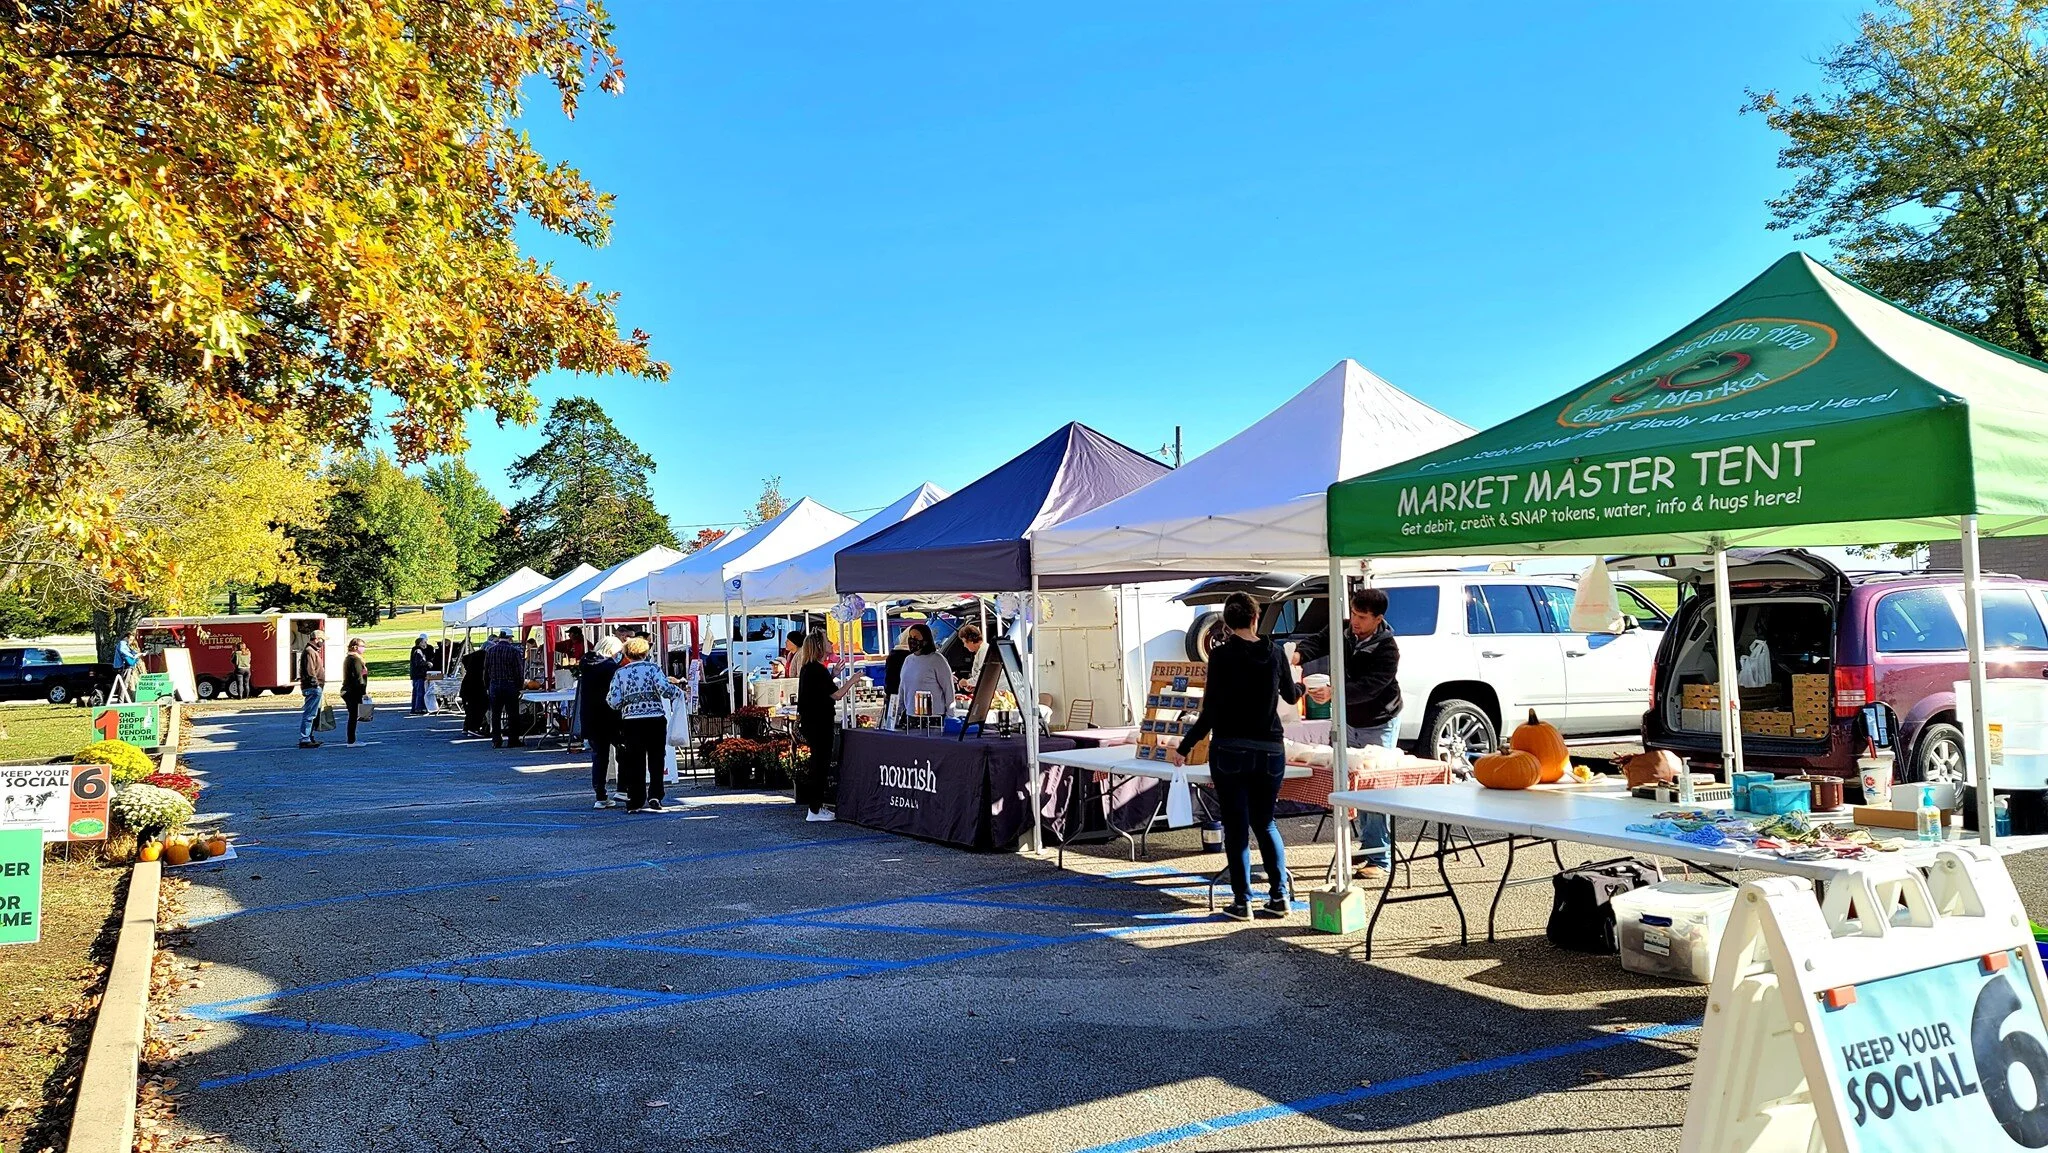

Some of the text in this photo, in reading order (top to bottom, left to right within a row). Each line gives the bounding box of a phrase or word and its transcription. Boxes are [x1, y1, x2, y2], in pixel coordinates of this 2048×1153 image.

[1610, 322, 1816, 385] The Sedalia Area
[1654, 372, 1770, 409] Market
[1628, 415, 1698, 430] Gladly
[1699, 400, 1820, 424] Accepted
[1819, 388, 1899, 411] Here!
[1397, 438, 1817, 518] MARKET MASTER TENT
[1401, 485, 1803, 536] Get debit, credit & SNAP tokens, water, info & hugs here!
[199, 636, 243, 646] KETTLE CORN
[1154, 665, 1207, 678] FRIED PIES
[94, 709, 119, 741] 1
[119, 728, 152, 736] VENDOR
[0, 769, 70, 778] KEEP YOUR
[6, 776, 70, 788] SOCIAL
[73, 767, 108, 800] 6
[879, 758, 937, 794] nourish
[1841, 1021, 1956, 1072] KEEP YOUR
[1970, 974, 2048, 1149] 6
[1847, 1051, 1980, 1128] SOCIAL
